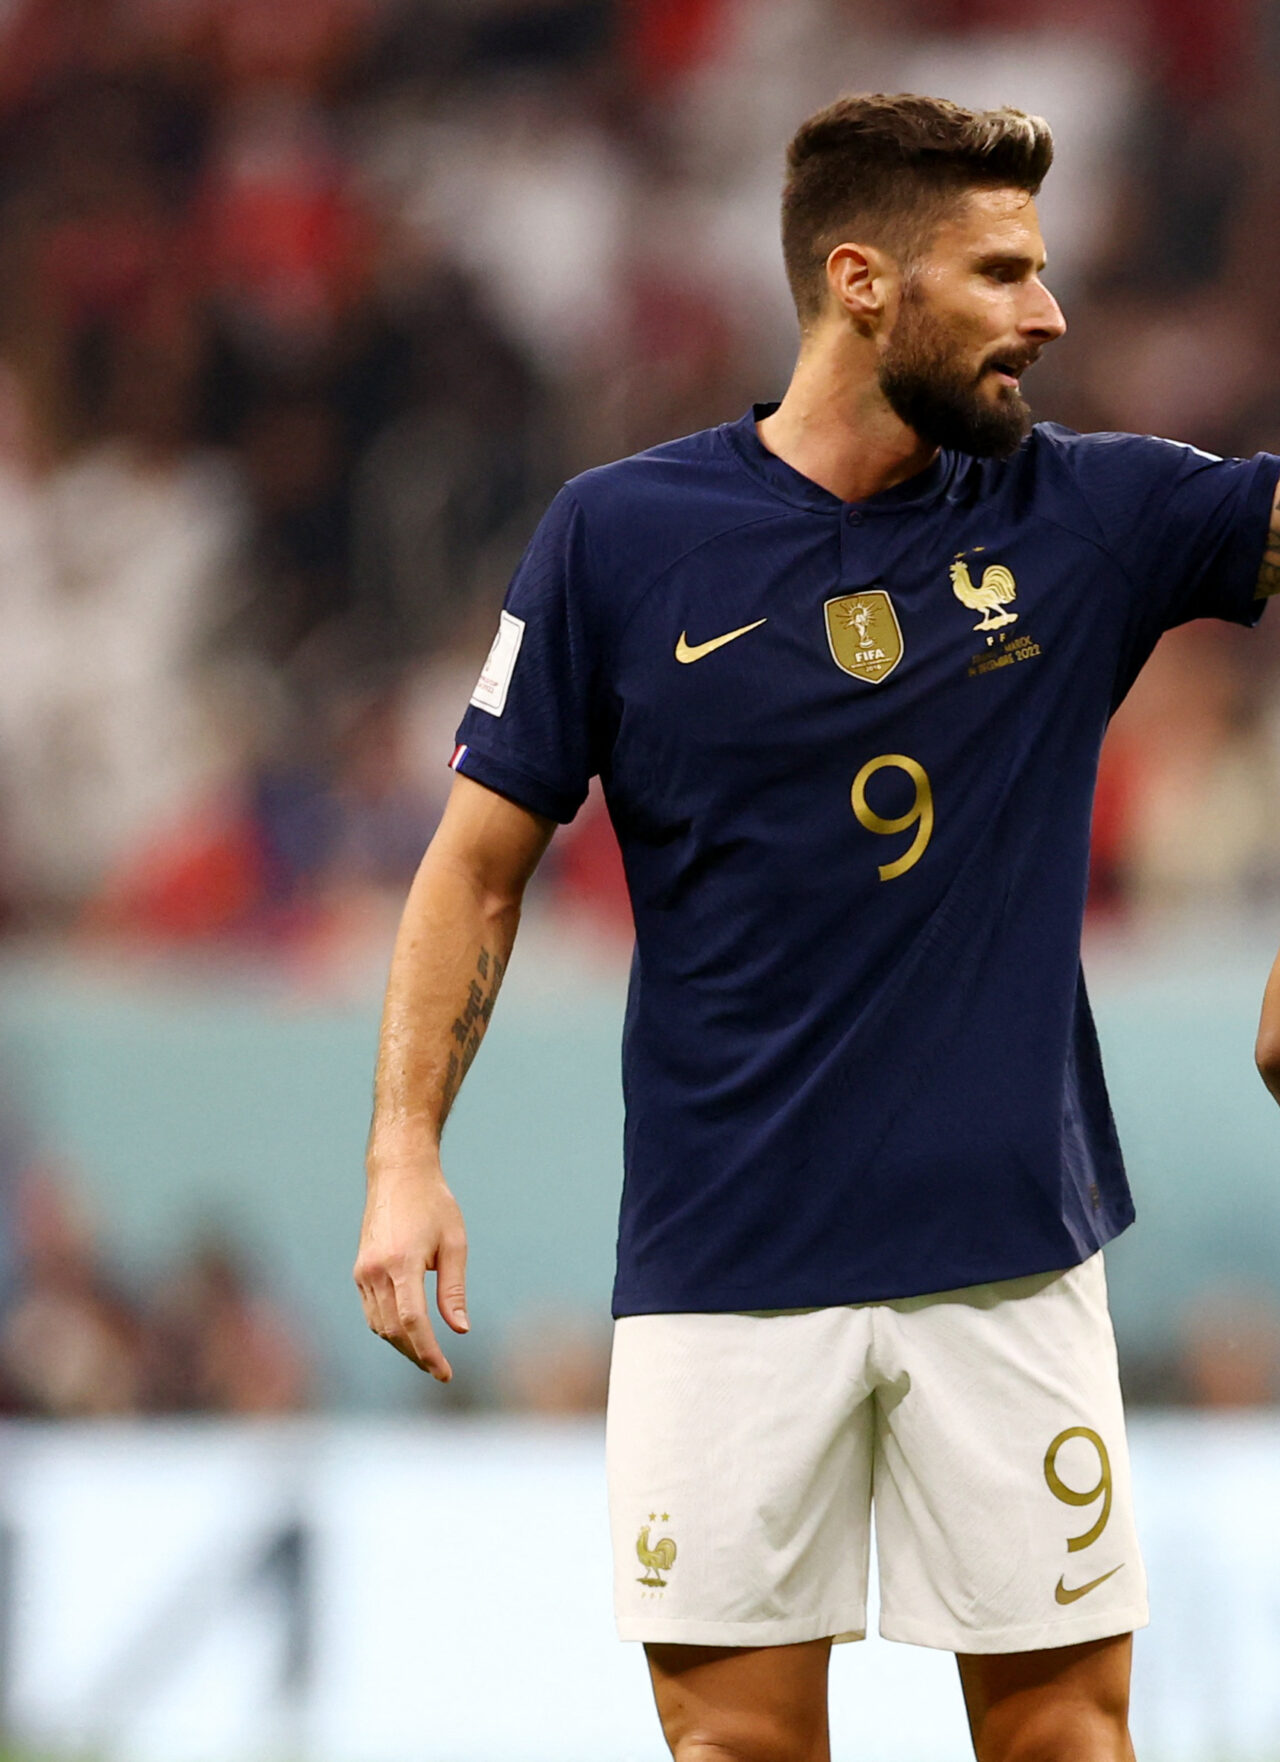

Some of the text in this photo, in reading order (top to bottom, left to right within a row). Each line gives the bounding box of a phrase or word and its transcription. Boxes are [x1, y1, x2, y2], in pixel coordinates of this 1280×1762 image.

[855, 648, 886, 663] FIFA
[1015, 644, 1042, 661] 2022
[851, 754, 934, 882] 9
[1044, 1426, 1112, 1553] 9
